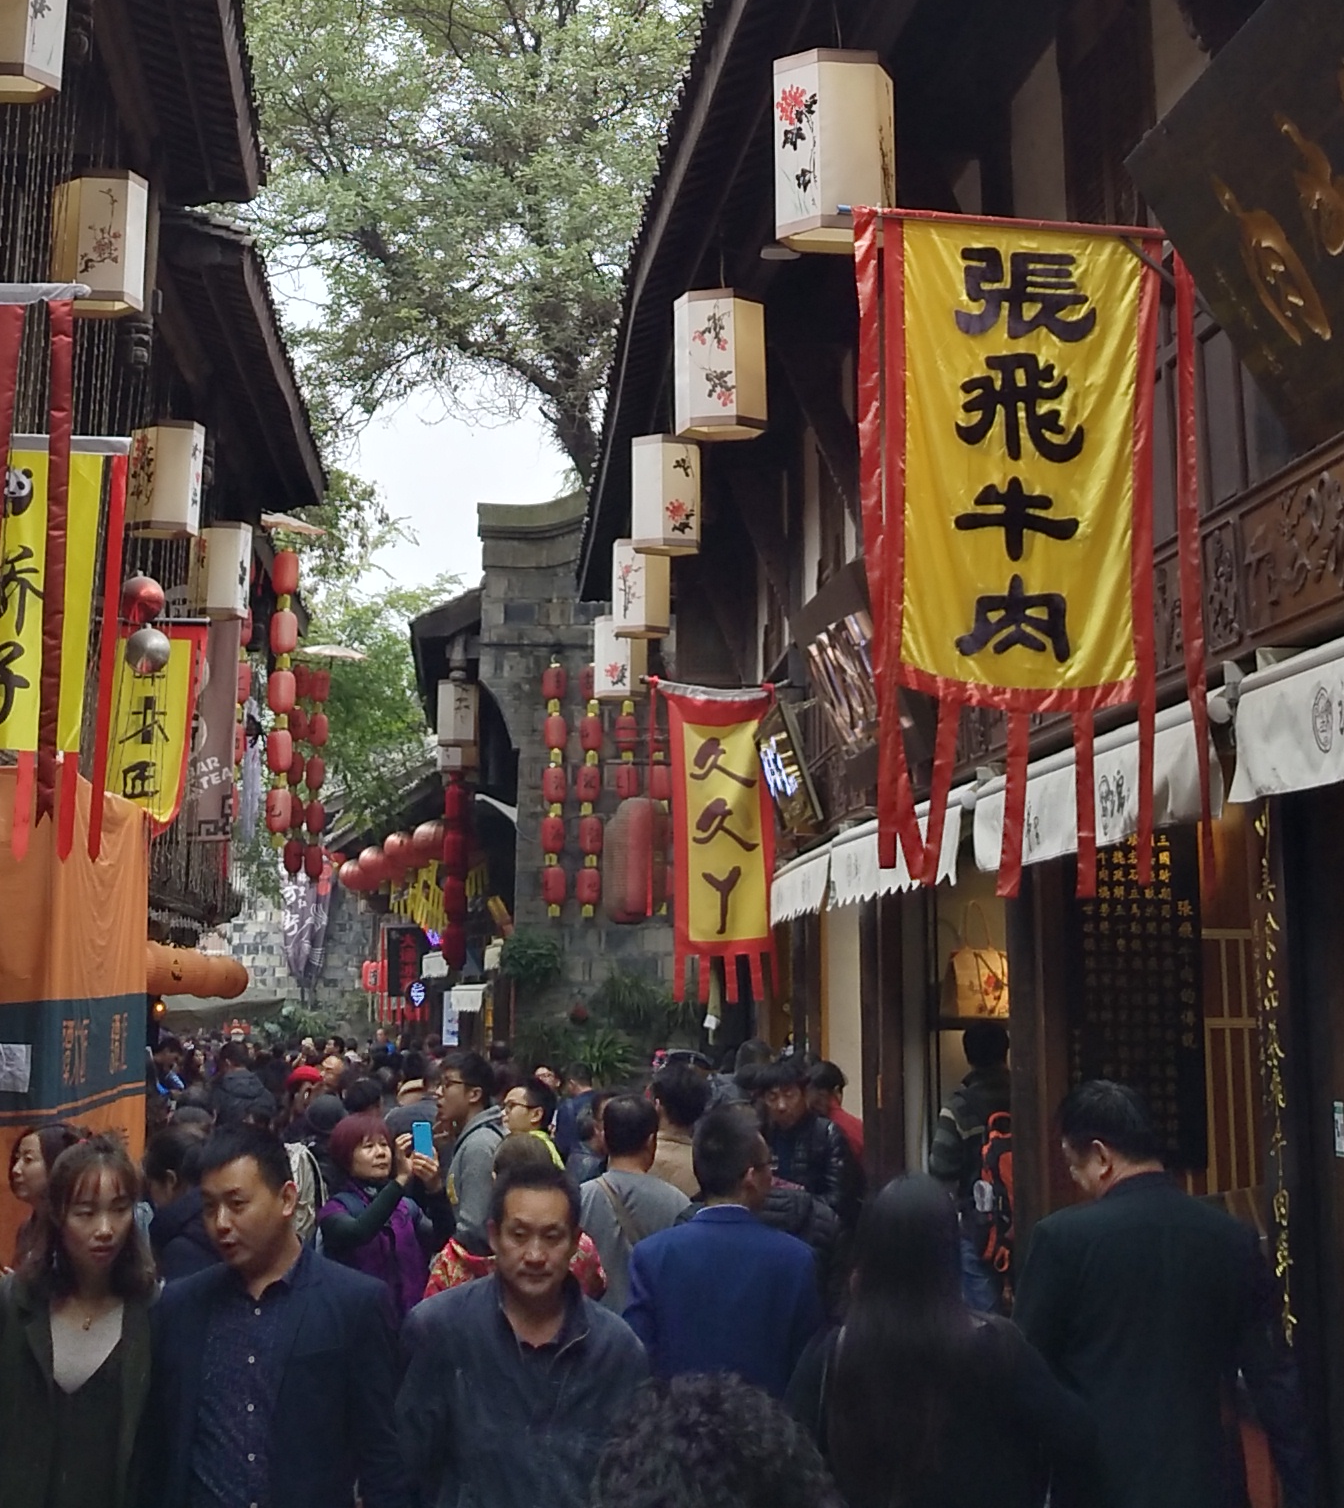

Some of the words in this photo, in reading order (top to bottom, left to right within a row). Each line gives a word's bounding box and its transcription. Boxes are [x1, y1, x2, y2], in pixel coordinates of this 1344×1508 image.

[955, 247, 1096, 663] 張飛牛肉
[118, 670, 171, 799] 木匠
[200, 767, 233, 790] TEA
[689, 737, 761, 935] 久久丫
